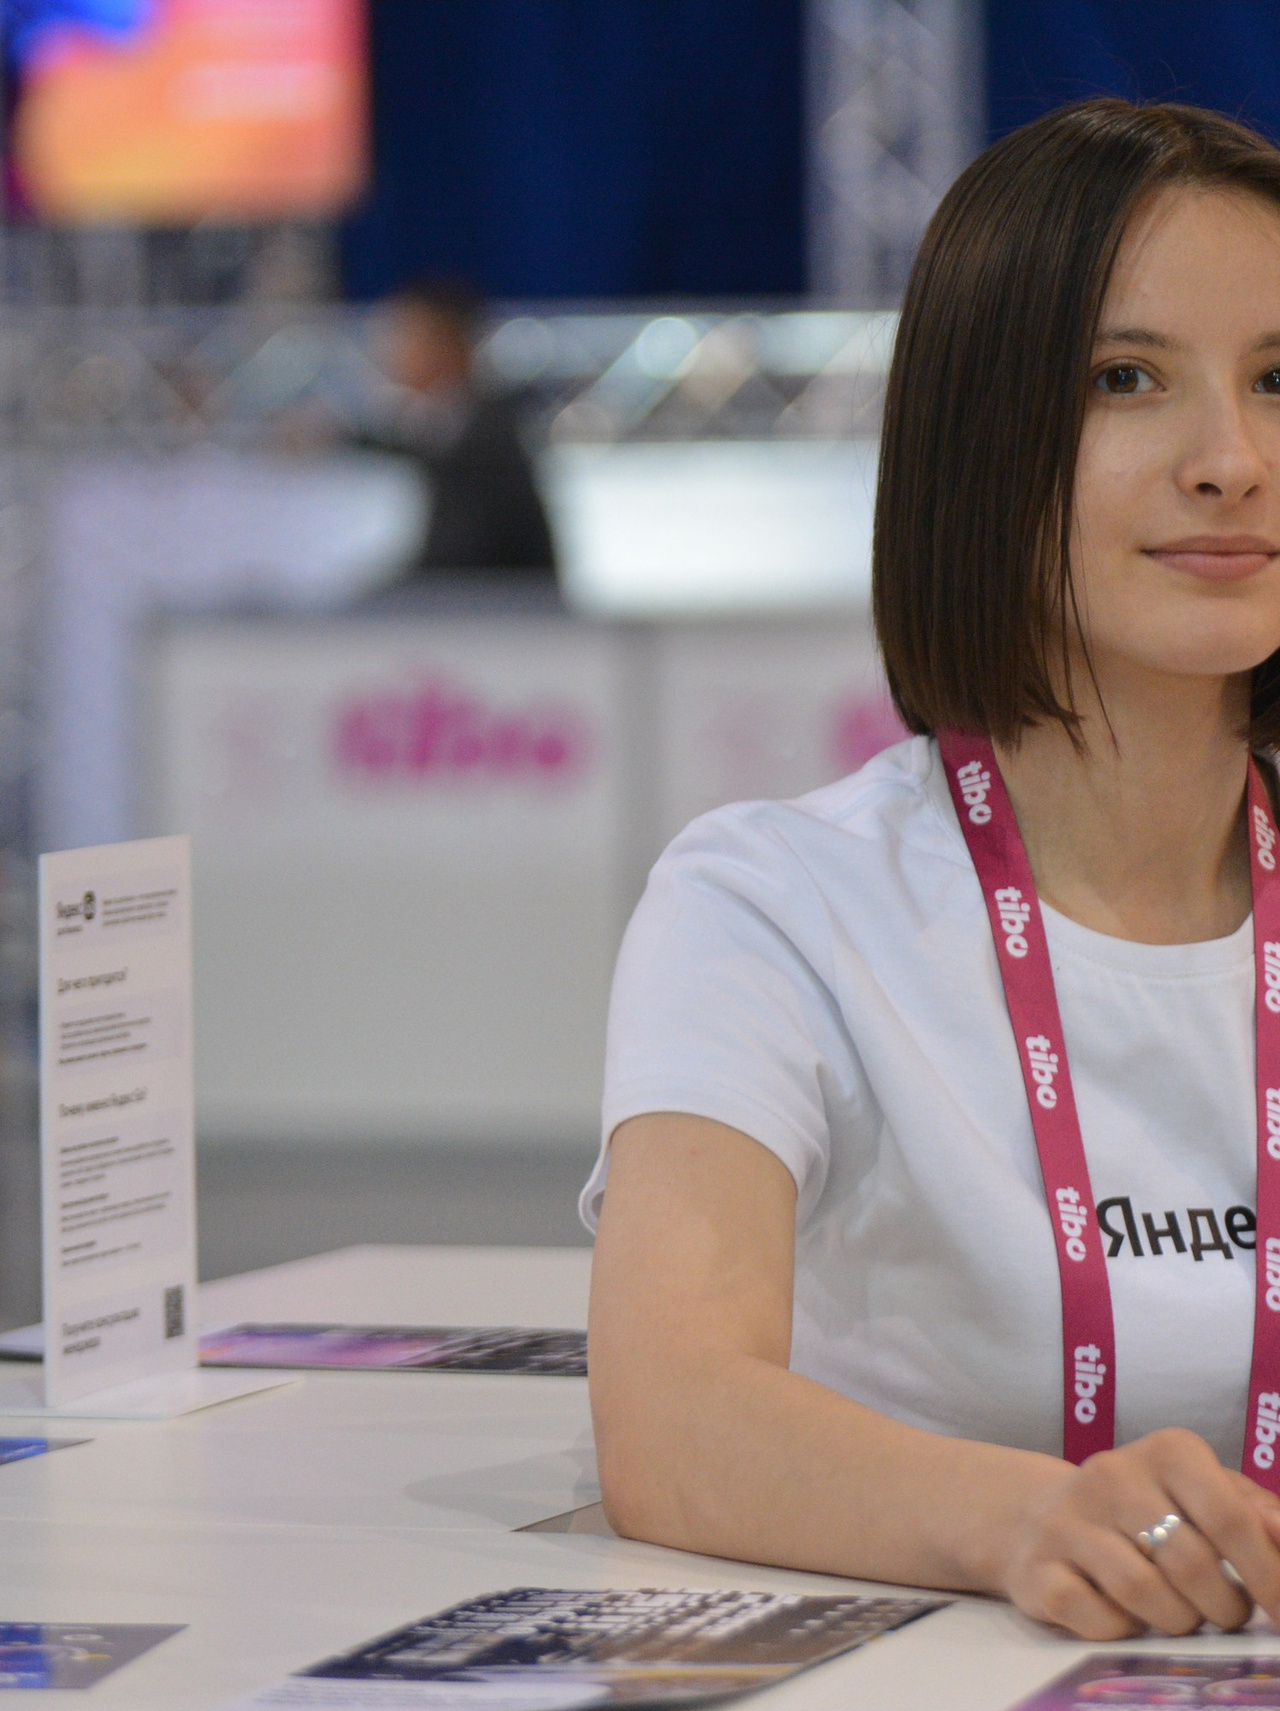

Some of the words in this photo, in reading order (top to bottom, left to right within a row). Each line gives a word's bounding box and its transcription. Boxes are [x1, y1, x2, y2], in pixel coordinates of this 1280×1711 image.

[1252, 804, 1276, 871] tibo
[957, 760, 992, 825] tibo
[994, 886, 1030, 959] tibo
[1025, 1034, 1059, 1109] tibo
[1055, 1186, 1088, 1263] tibo
[1074, 1343, 1107, 1424] tibo
